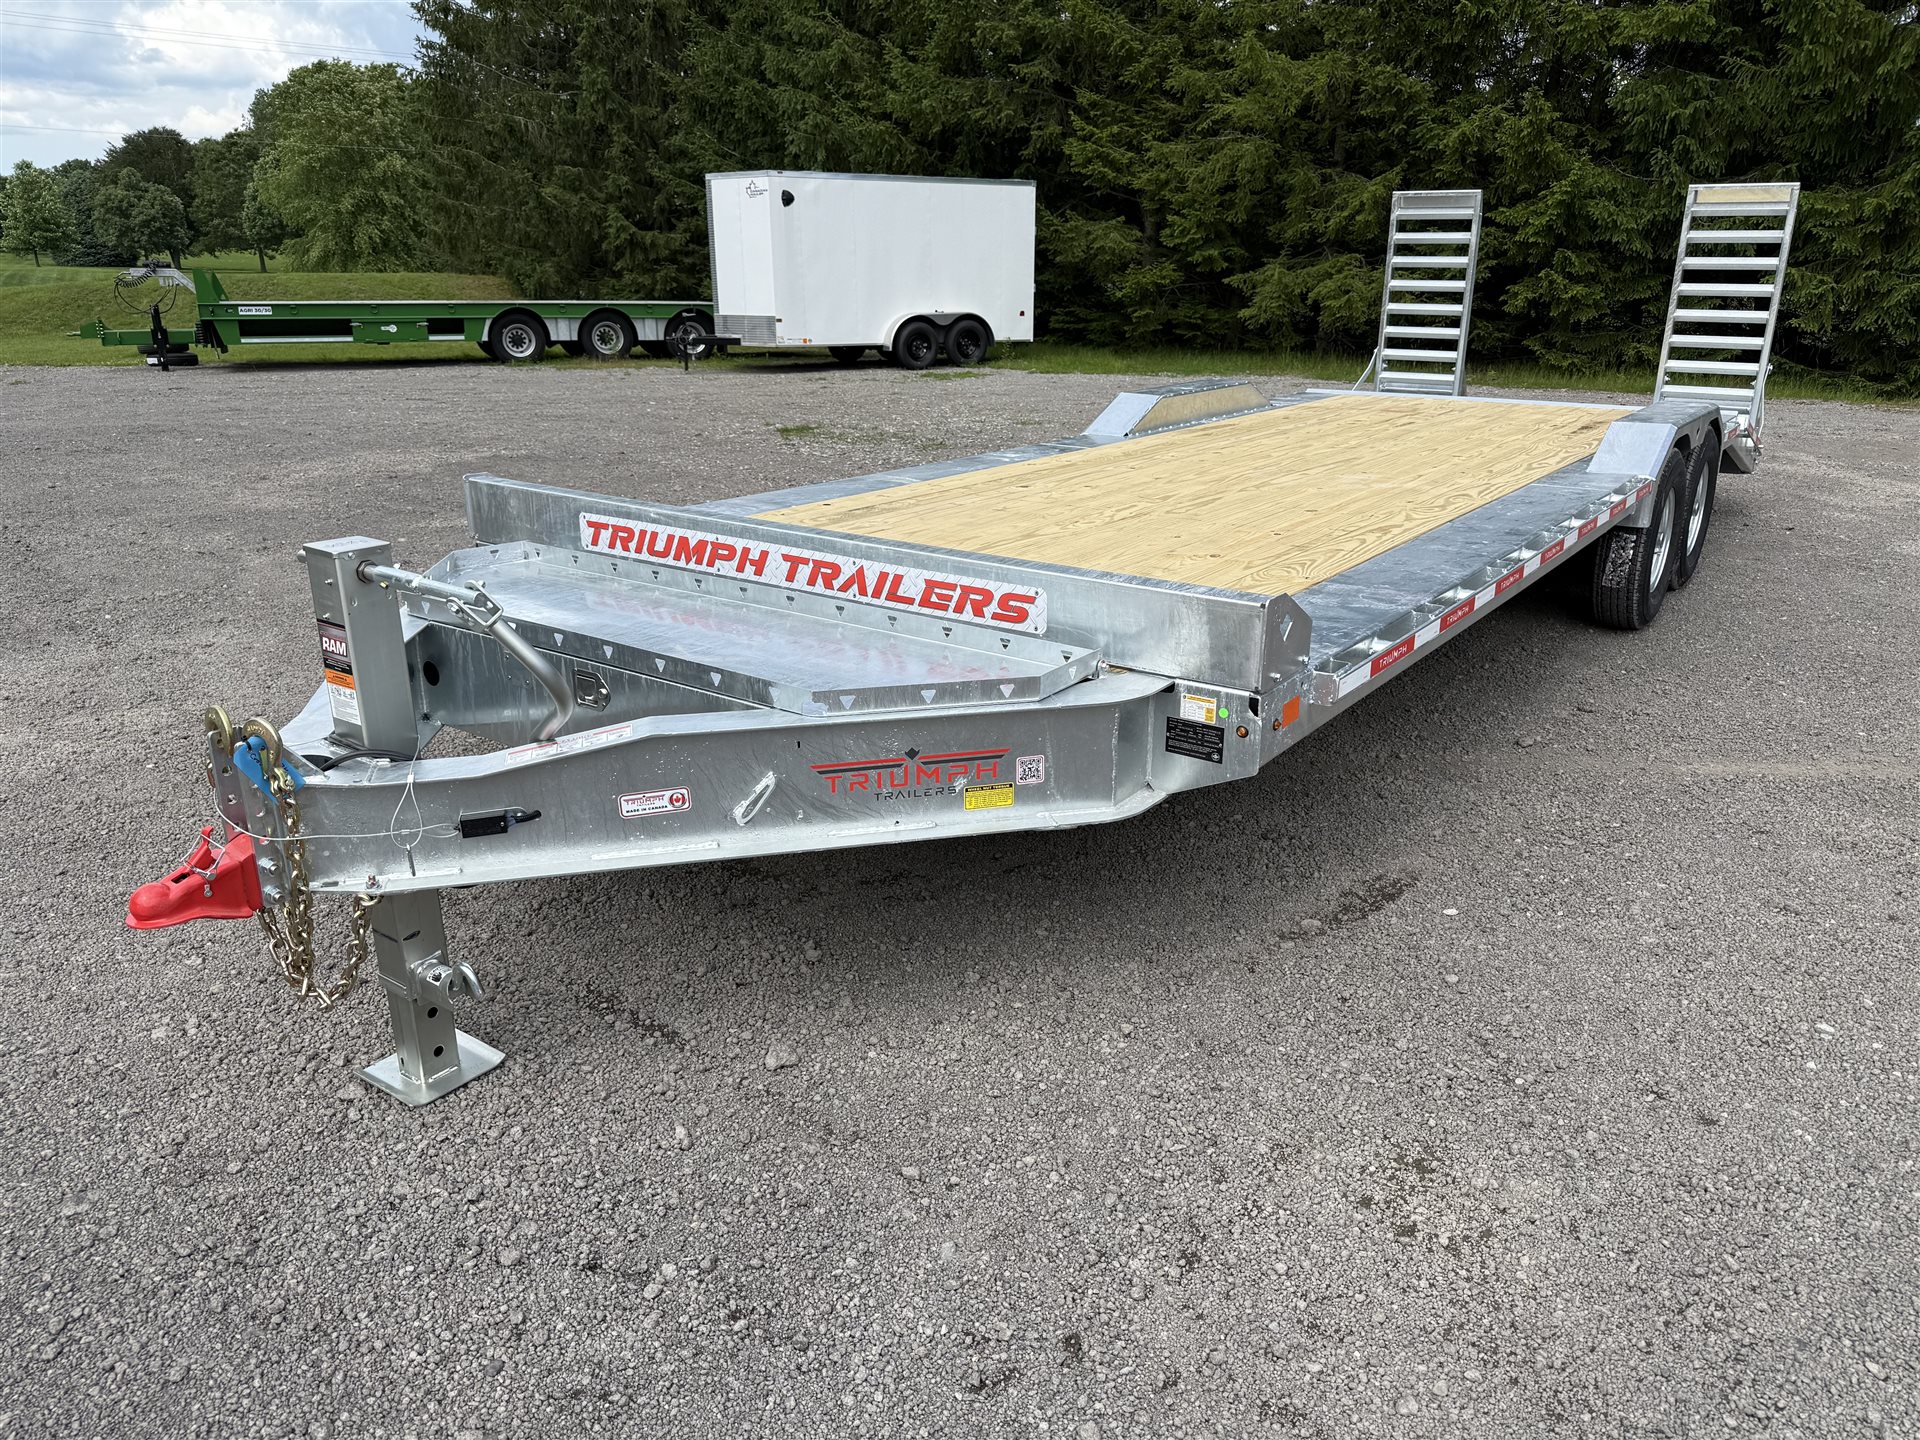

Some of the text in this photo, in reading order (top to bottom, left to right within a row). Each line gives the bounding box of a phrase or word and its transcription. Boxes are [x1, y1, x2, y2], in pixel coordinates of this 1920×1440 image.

[1545, 545, 1561, 560] TRIUMPH
[586, 520, 1037, 624] TRIUMPH TRAILERS
[1500, 572, 1520, 590] TRIUMPH
[1446, 605, 1469, 626] TRIUMPH
[322, 637, 347, 656] RAM
[1378, 644, 1408, 668] TRIUMPH
[823, 761, 998, 794] TRIUMPH
[873, 786, 957, 802] TRAILERS
[626, 803, 640, 813] MADE
[648, 800, 668, 810] CANADA
